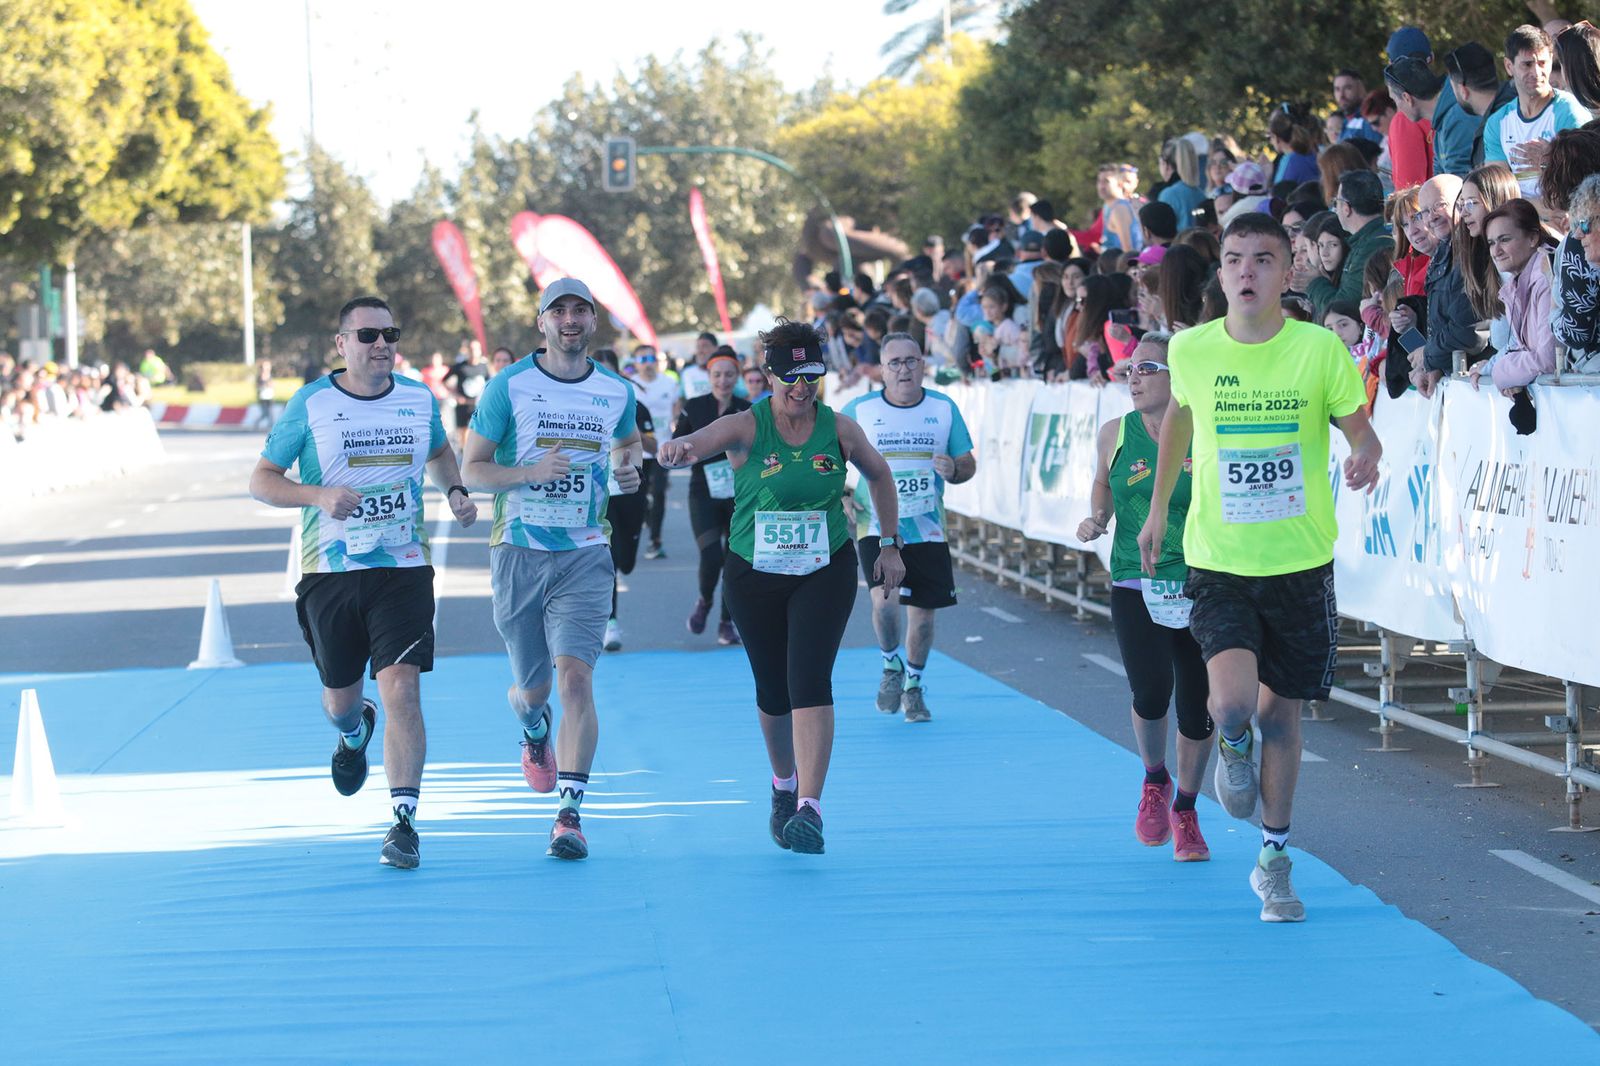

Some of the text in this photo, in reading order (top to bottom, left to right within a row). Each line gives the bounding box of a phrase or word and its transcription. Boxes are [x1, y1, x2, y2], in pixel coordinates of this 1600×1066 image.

[1214, 388, 1300, 399] Medio Maratón
[1215, 400, 1262, 411] Almería
[538, 412, 604, 424] Medio Maratón
[537, 420, 576, 430] Almería
[341, 427, 414, 439] Medio Maratón
[343, 437, 386, 450] Almería
[877, 437, 911, 446] Almería
[1228, 459, 1294, 484] 5289
[894, 477, 929, 493] 285
[1248, 483, 1274, 491] JAVIER
[363, 513, 396, 523] PARRARRO
[763, 523, 821, 544] 5517
[1151, 579, 1184, 595] 50
